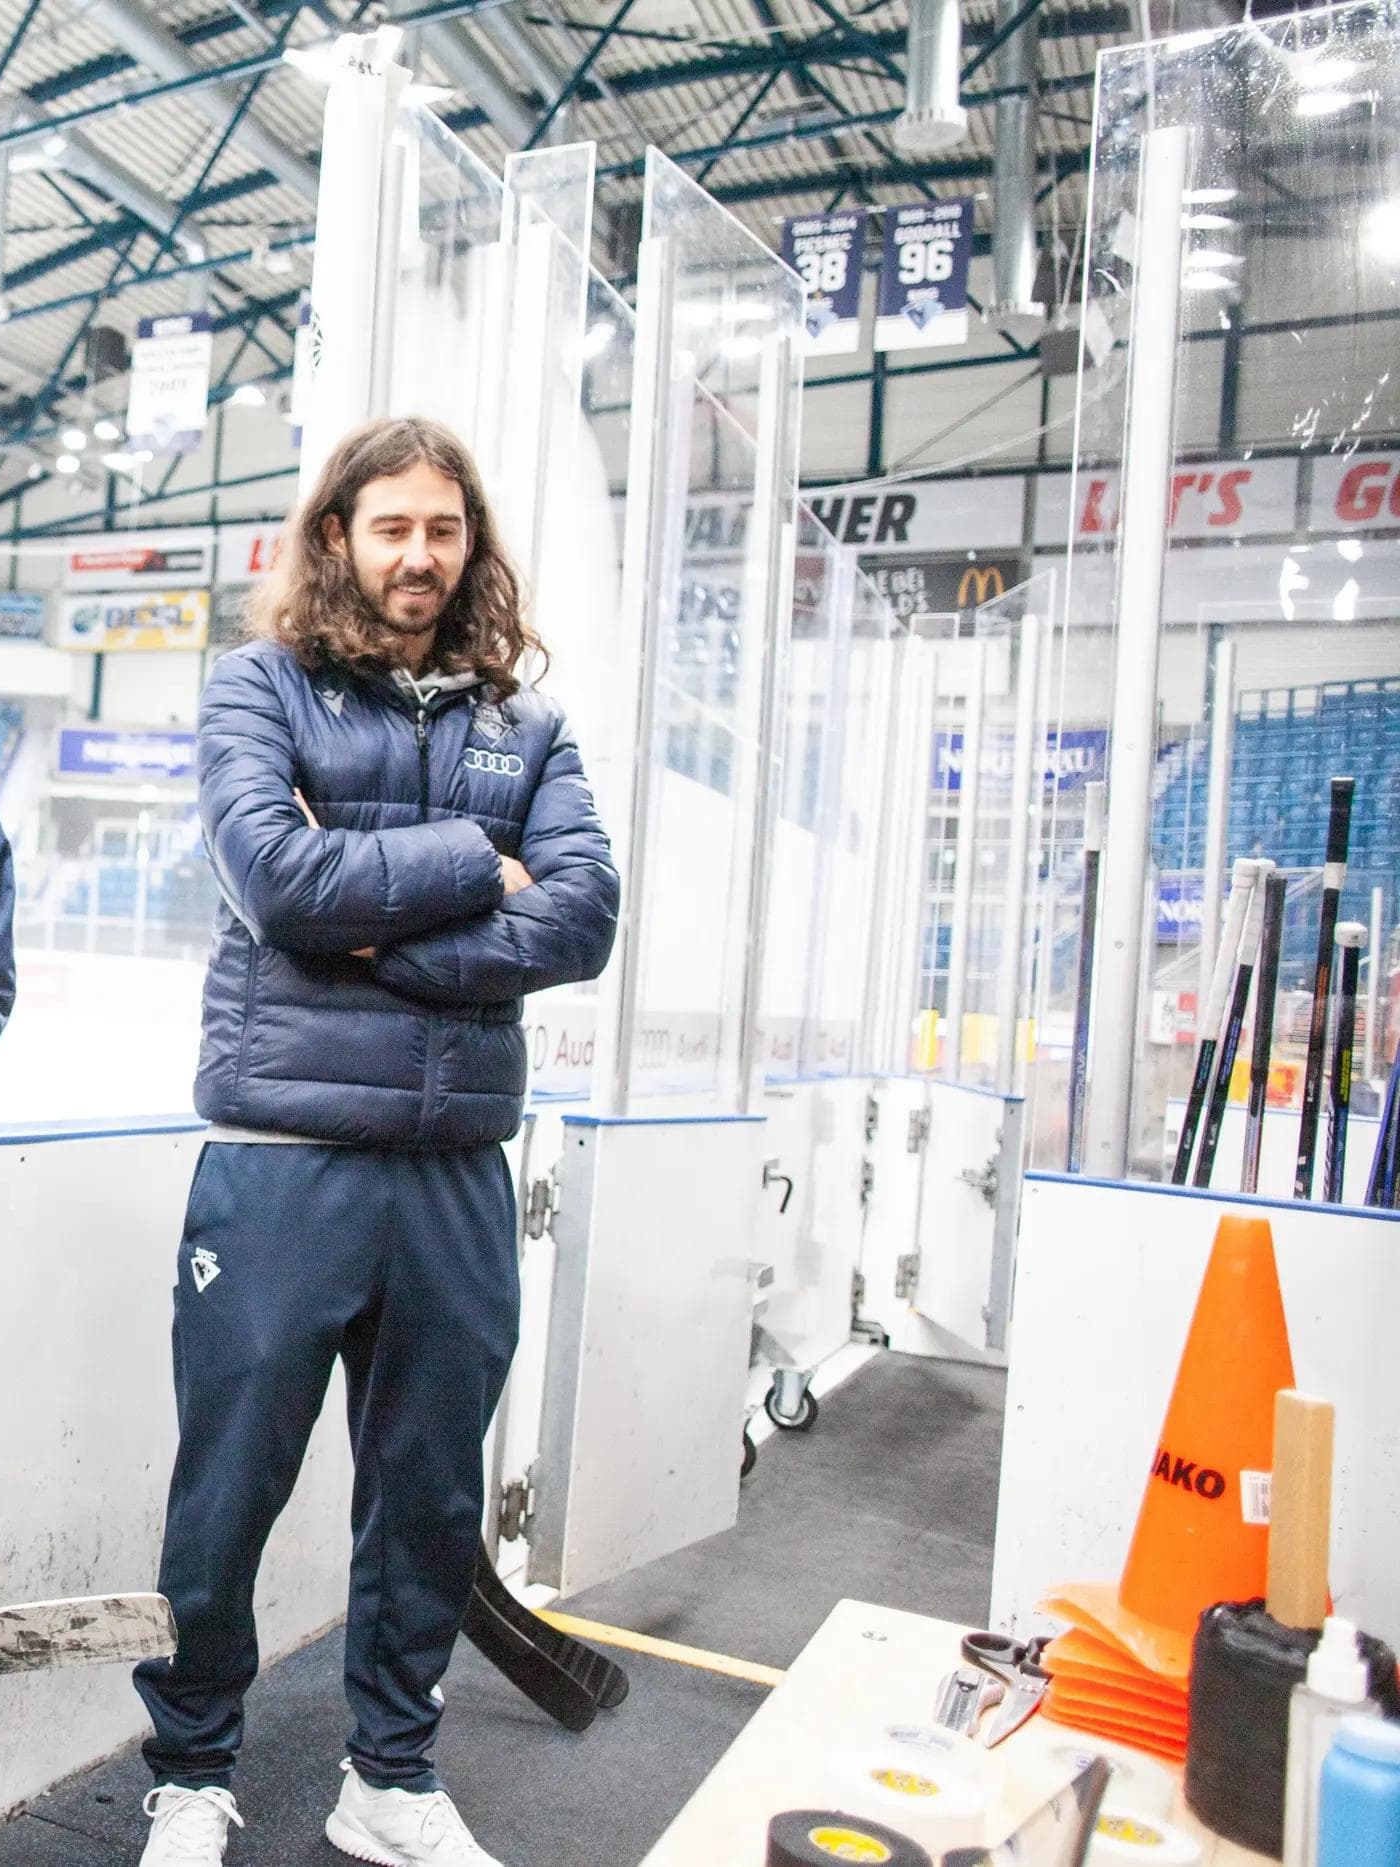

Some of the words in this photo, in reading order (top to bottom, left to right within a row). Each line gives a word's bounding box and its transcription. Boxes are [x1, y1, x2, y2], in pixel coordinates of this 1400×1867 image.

[796, 250, 848, 293] 38
[898, 239, 954, 285] 96
[1079, 469, 1253, 533] LT'S
[1334, 461, 1400, 522] G
[553, 1031, 596, 1067] Aud
